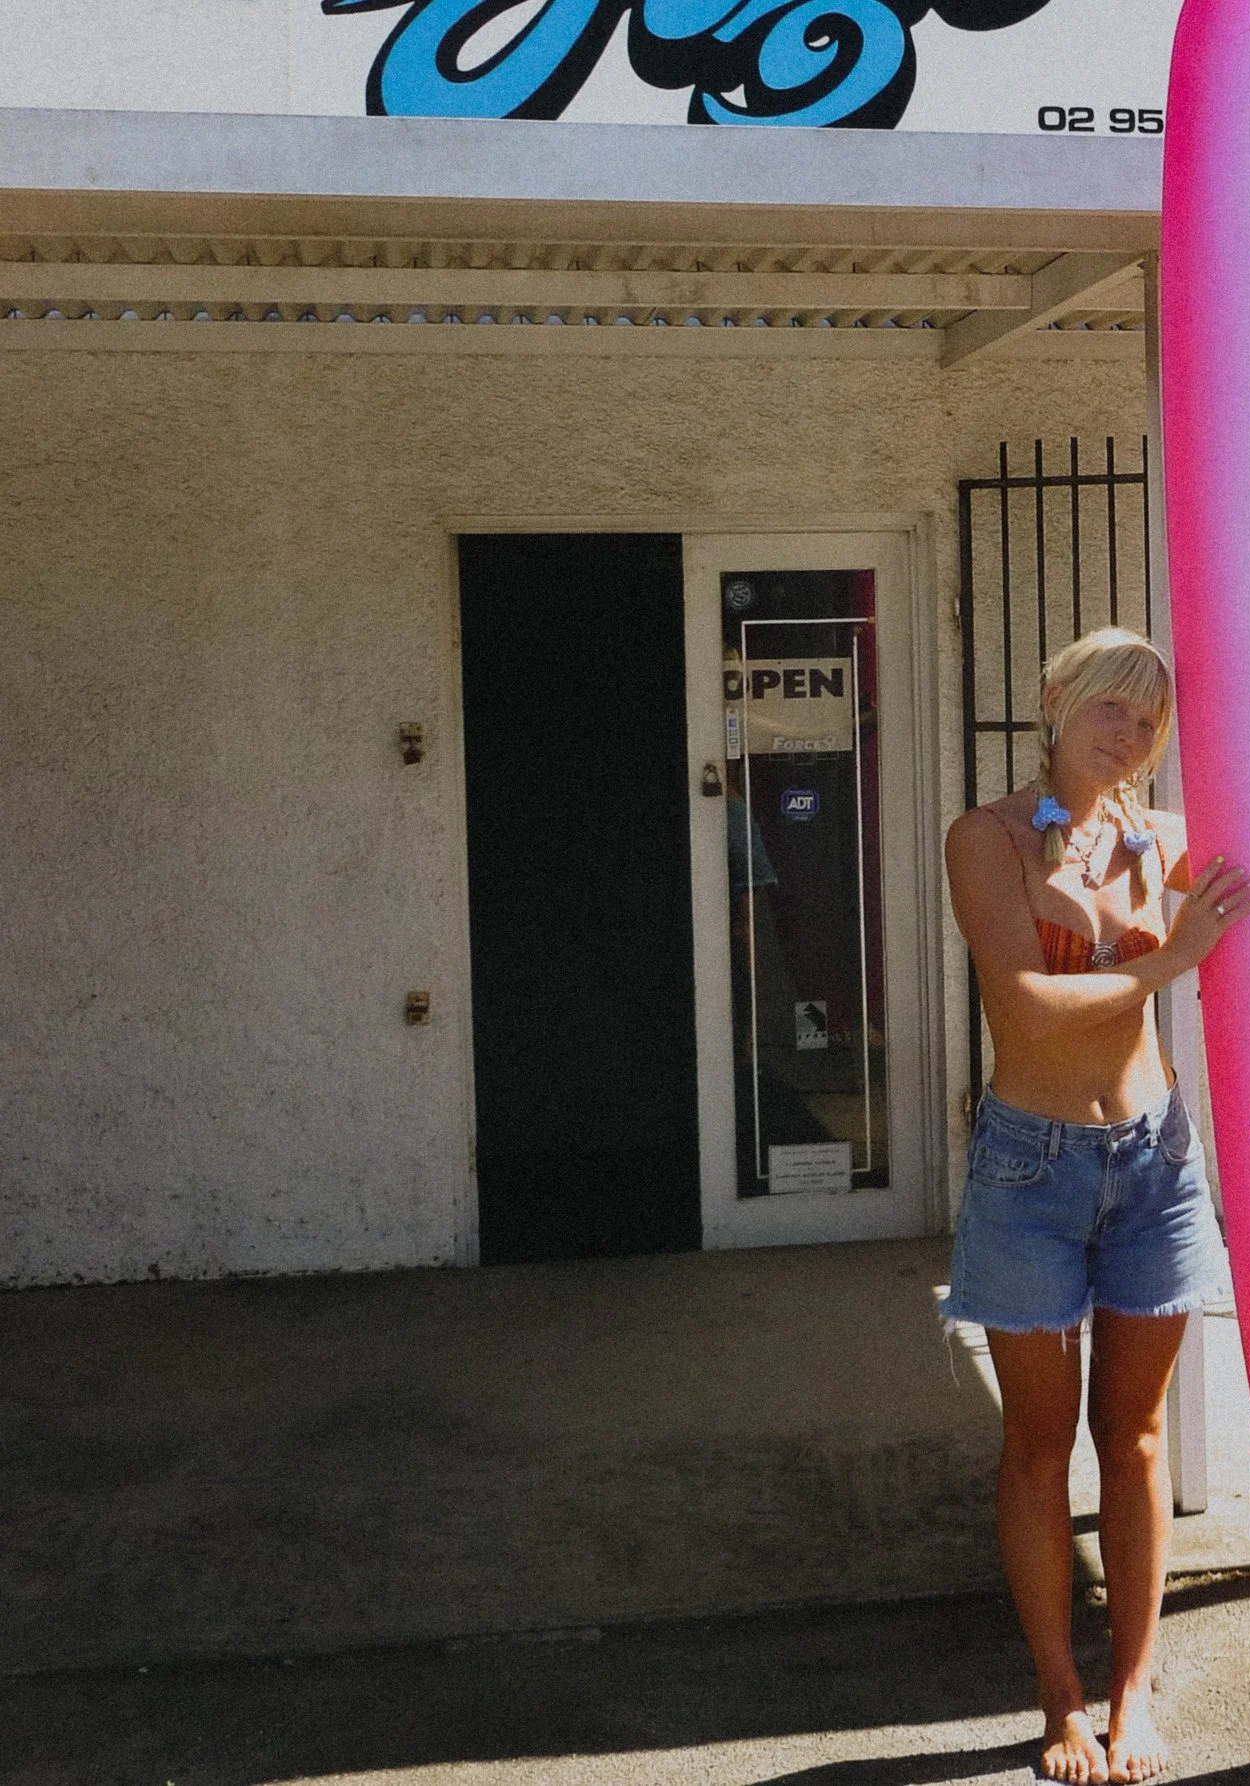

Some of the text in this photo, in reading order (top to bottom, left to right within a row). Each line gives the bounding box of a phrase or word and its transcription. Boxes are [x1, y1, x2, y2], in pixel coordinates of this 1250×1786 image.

[1038, 106, 1164, 134] 02 95
[722, 668, 844, 700] OPEN
[787, 796, 814, 810] ADT
